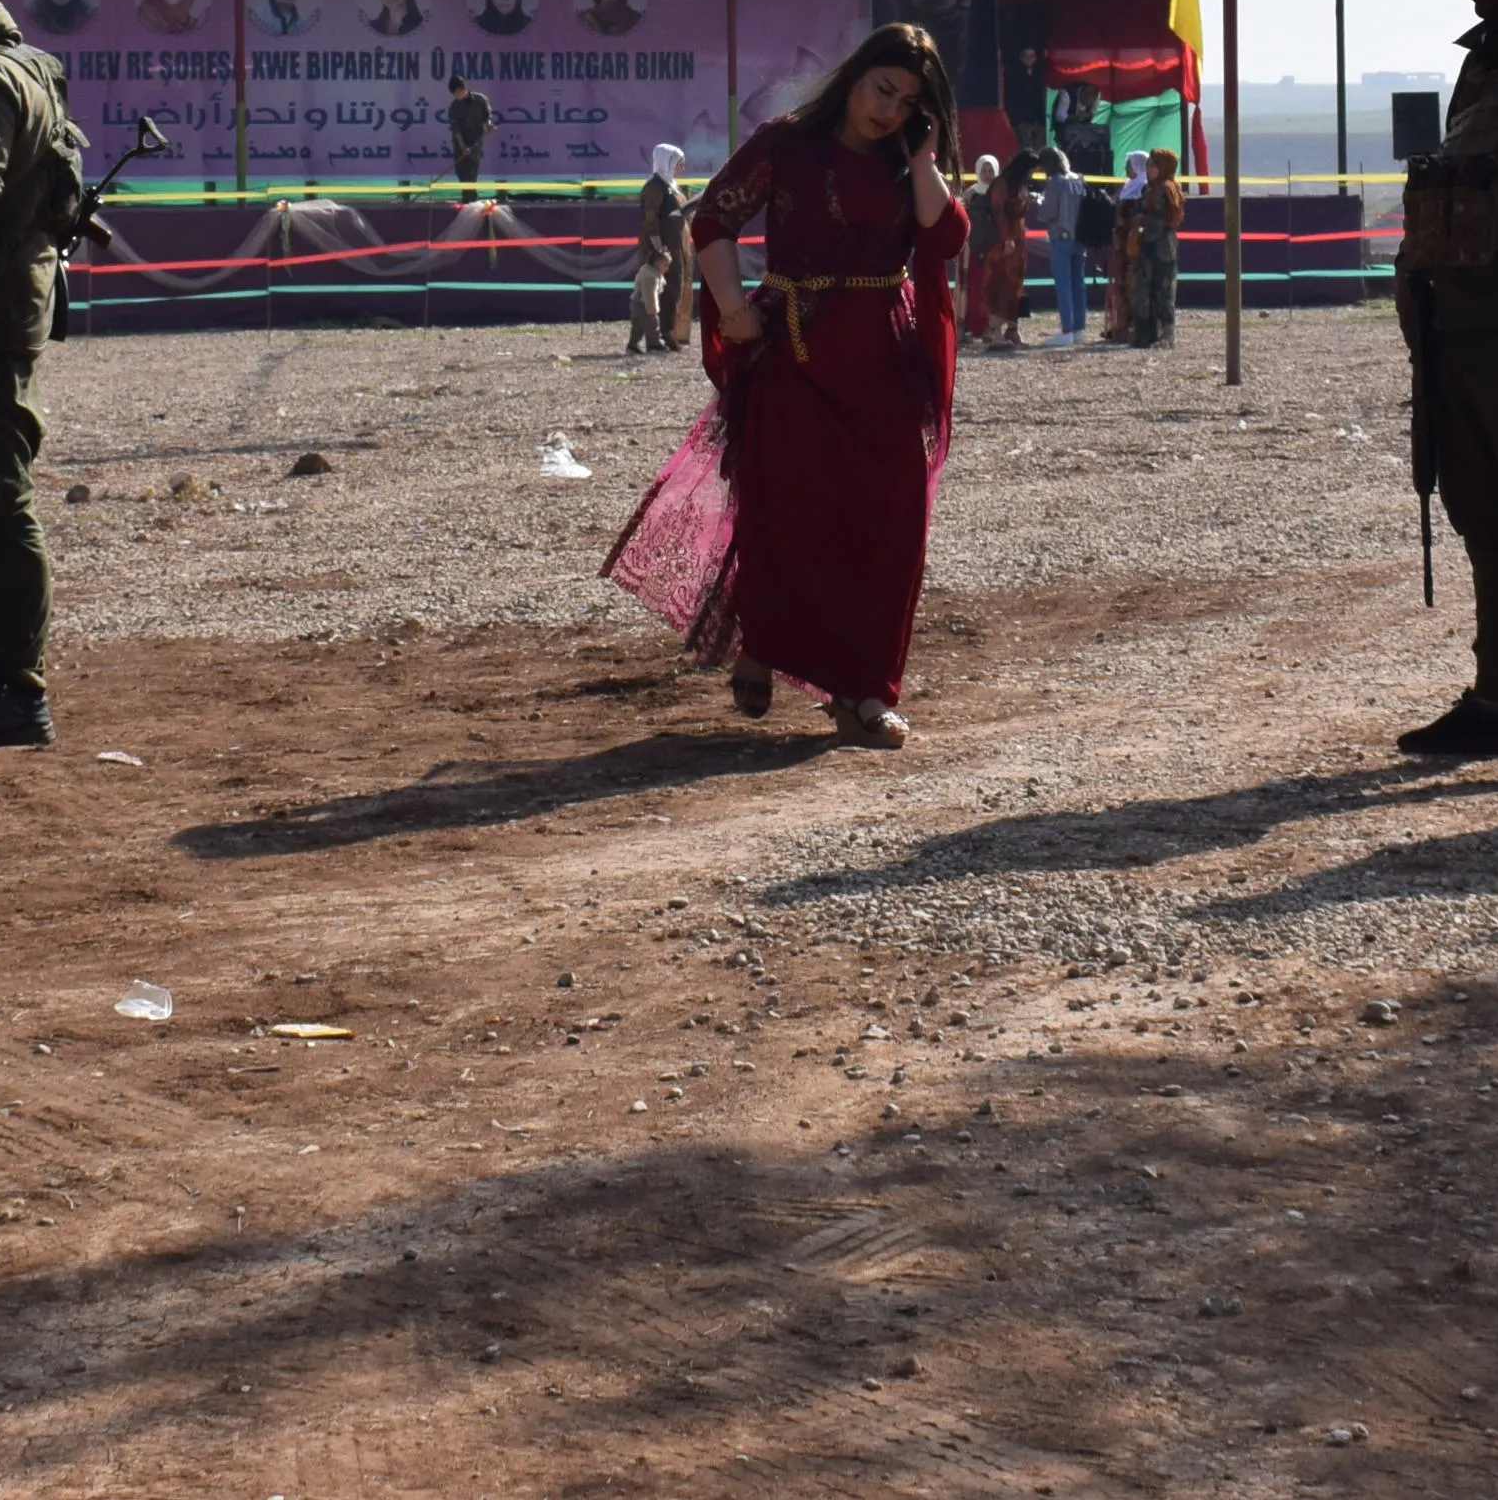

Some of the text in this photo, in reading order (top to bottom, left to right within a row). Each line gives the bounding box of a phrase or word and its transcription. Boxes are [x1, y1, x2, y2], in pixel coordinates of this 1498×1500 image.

[79, 50, 121, 81] HEV
[126, 50, 155, 81] RE
[159, 50, 246, 86] ŞOREŞ
[251, 50, 300, 81] XWE
[306, 45, 419, 81] BIPARÊZIN
[430, 46, 445, 81] Û
[450, 51, 494, 81] AXA
[499, 51, 546, 81] XWE
[551, 51, 629, 81] RIZGAR
[635, 51, 694, 81] BIKIN
[102, 91, 225, 132] أراضينا
[303, 107, 328, 131] و
[335, 96, 430, 131] ثورتنا
